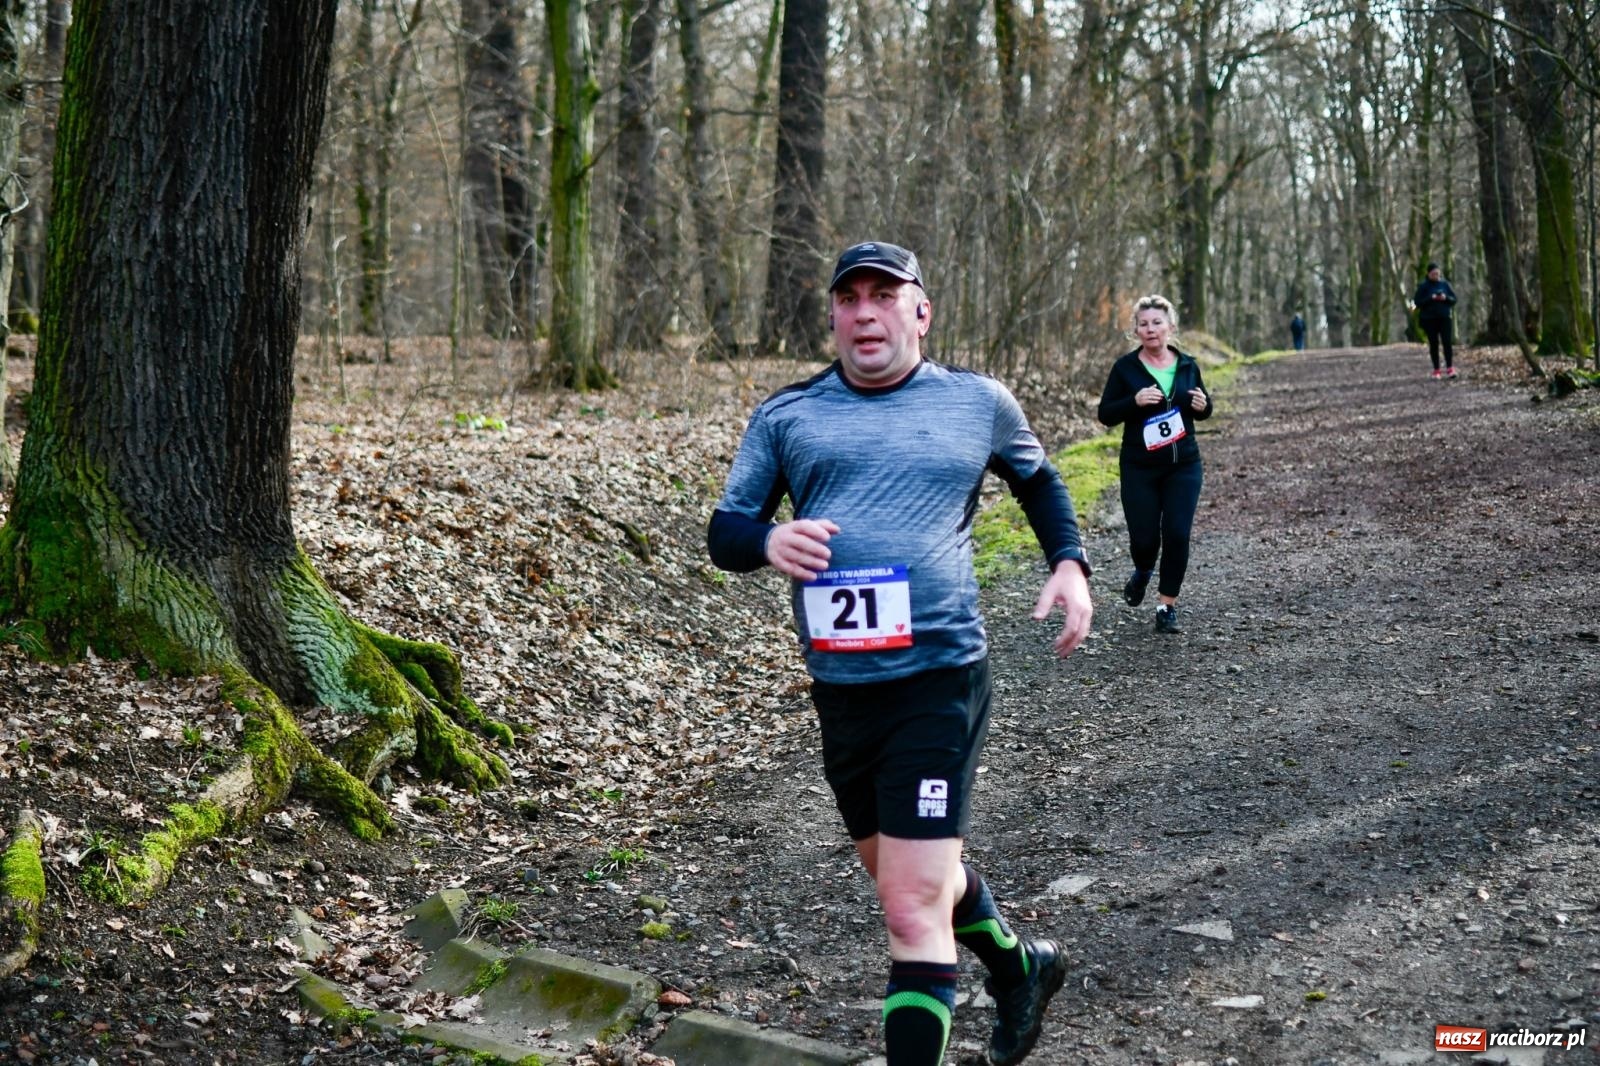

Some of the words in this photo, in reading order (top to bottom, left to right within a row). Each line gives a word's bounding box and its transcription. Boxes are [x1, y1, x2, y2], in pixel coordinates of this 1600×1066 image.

[1158, 421, 1171, 437] 8
[840, 567, 894, 578] TWARDZIELA
[831, 588, 878, 630] 21
[918, 799, 947, 810] CROSS
